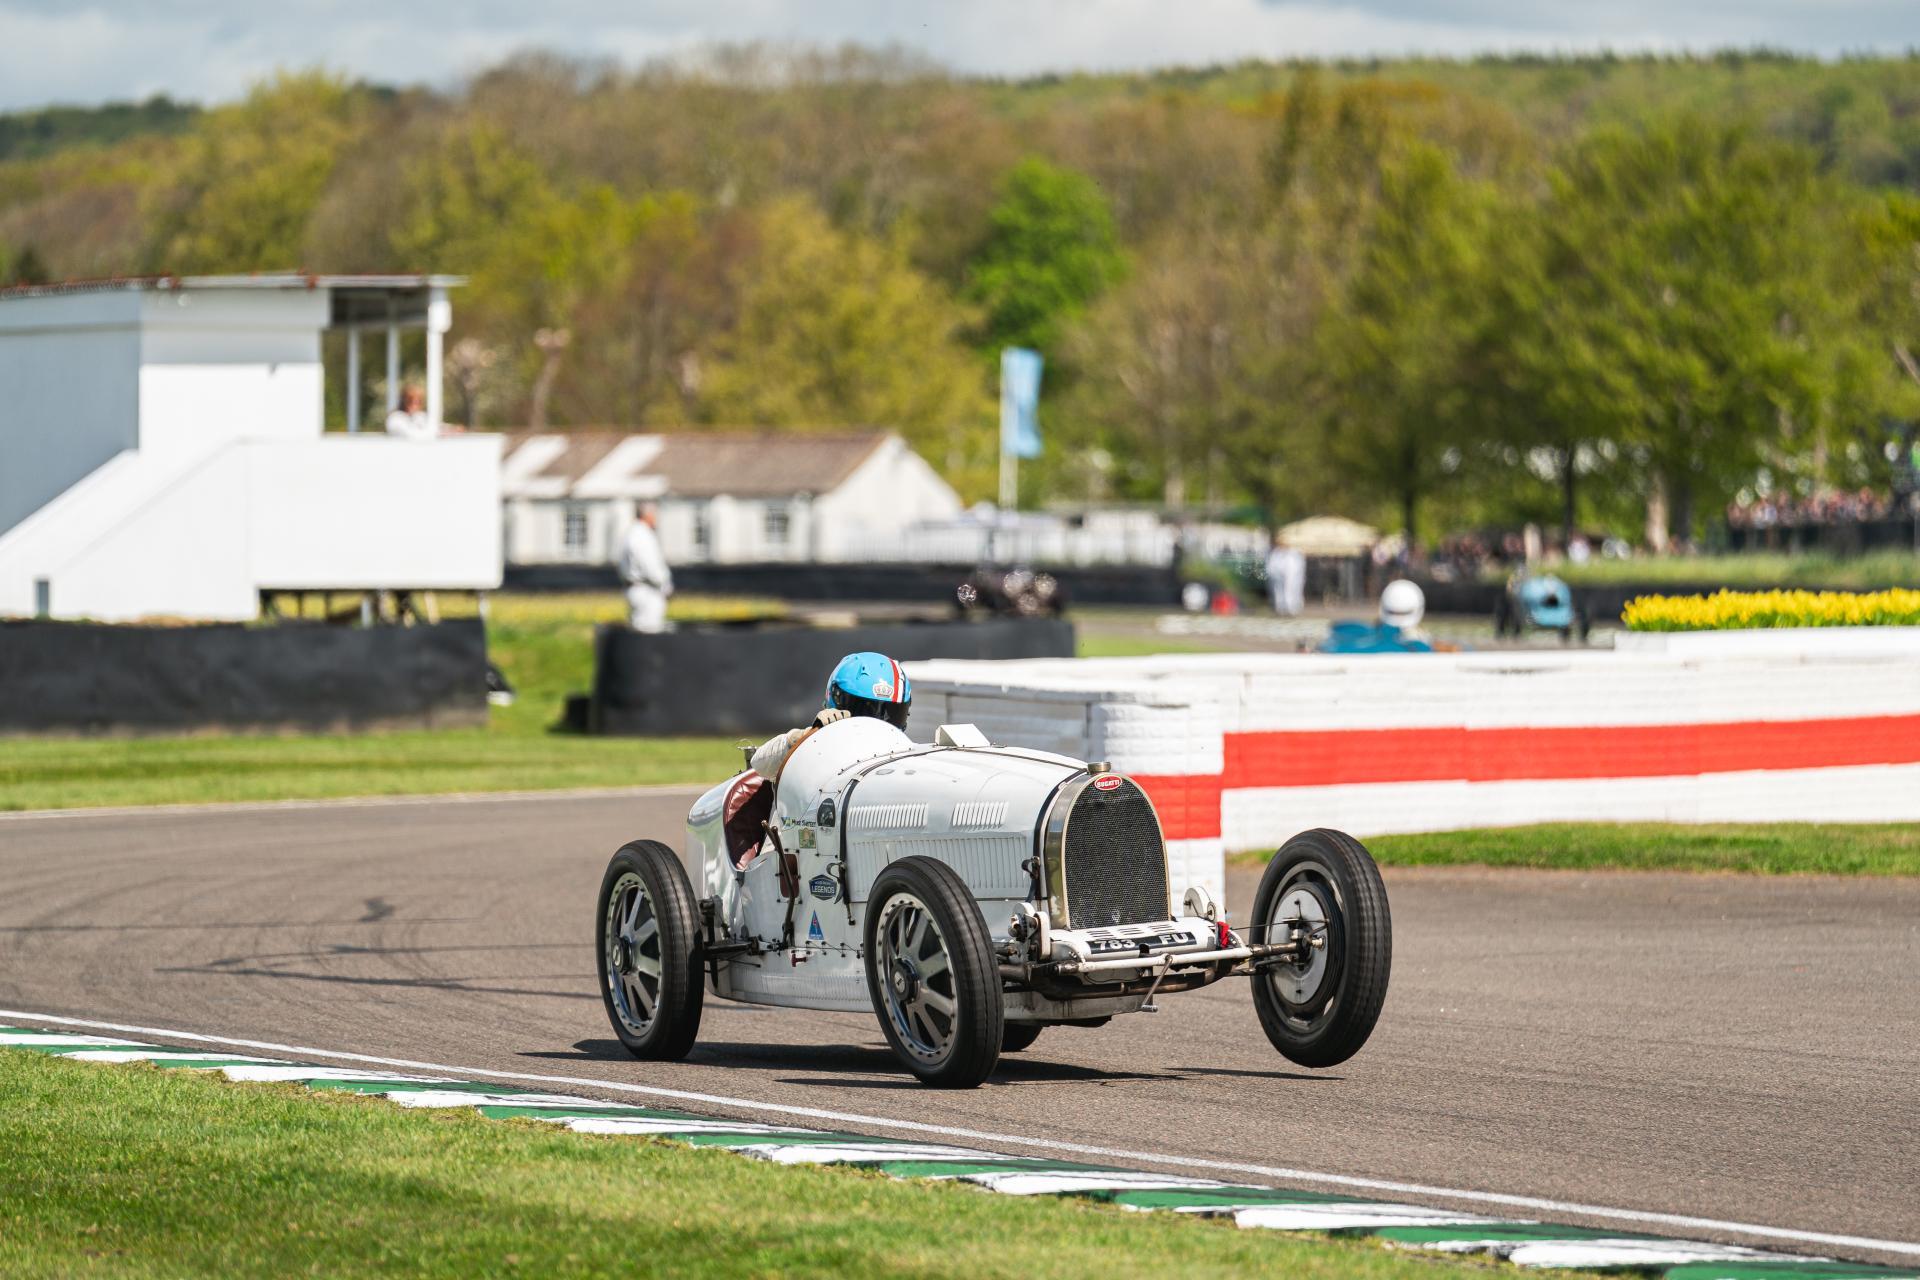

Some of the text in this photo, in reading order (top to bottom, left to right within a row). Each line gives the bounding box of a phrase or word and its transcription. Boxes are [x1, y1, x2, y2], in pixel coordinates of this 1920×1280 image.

[1096, 780, 1120, 788] BUGATTI
[811, 885, 835, 894] LEGENDS
[1094, 933, 1189, 951] 783 FU
